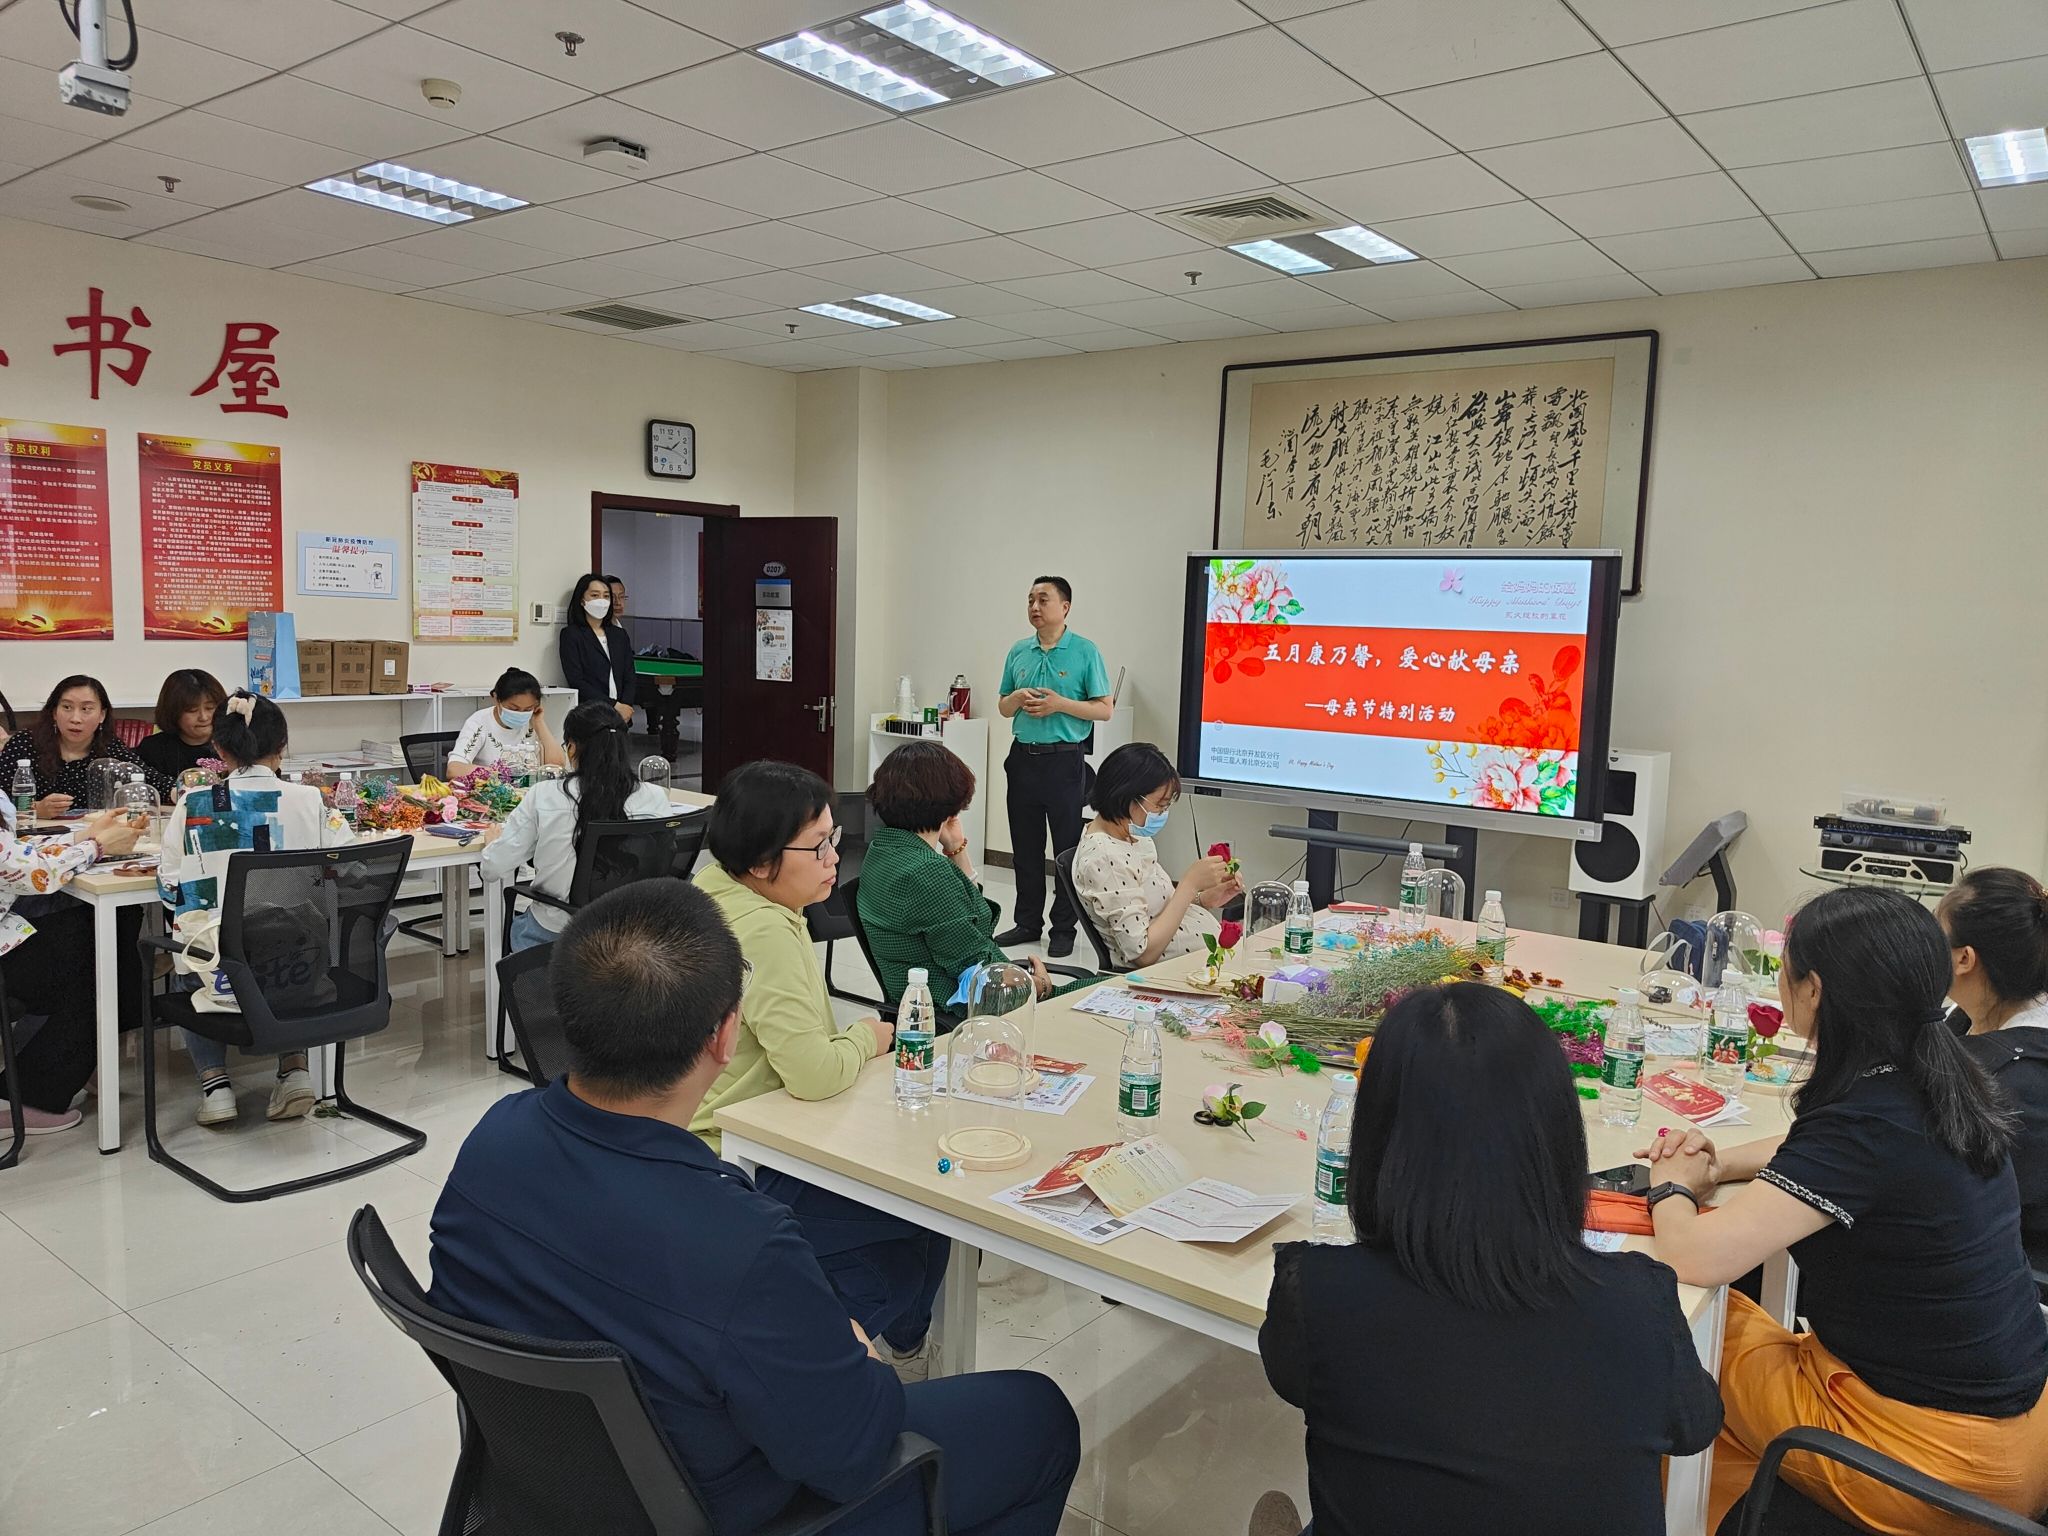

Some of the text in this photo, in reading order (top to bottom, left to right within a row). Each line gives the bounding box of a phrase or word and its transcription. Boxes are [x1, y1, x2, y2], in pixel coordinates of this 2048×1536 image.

[0, 287, 288, 418] 书屋
[4, 442, 51, 456] 党员权利
[192, 460, 233, 472] 党员义务
[331, 545, 368, 555] 温馨提示
[766, 565, 781, 573] 0207
[1262, 641, 1521, 676] 五月康乃馨，爱心献母亲
[1211, 747, 1280, 760] 中国银行北京开发区分行
[1210, 755, 1280, 769] 中银三星人寿北京分公司
